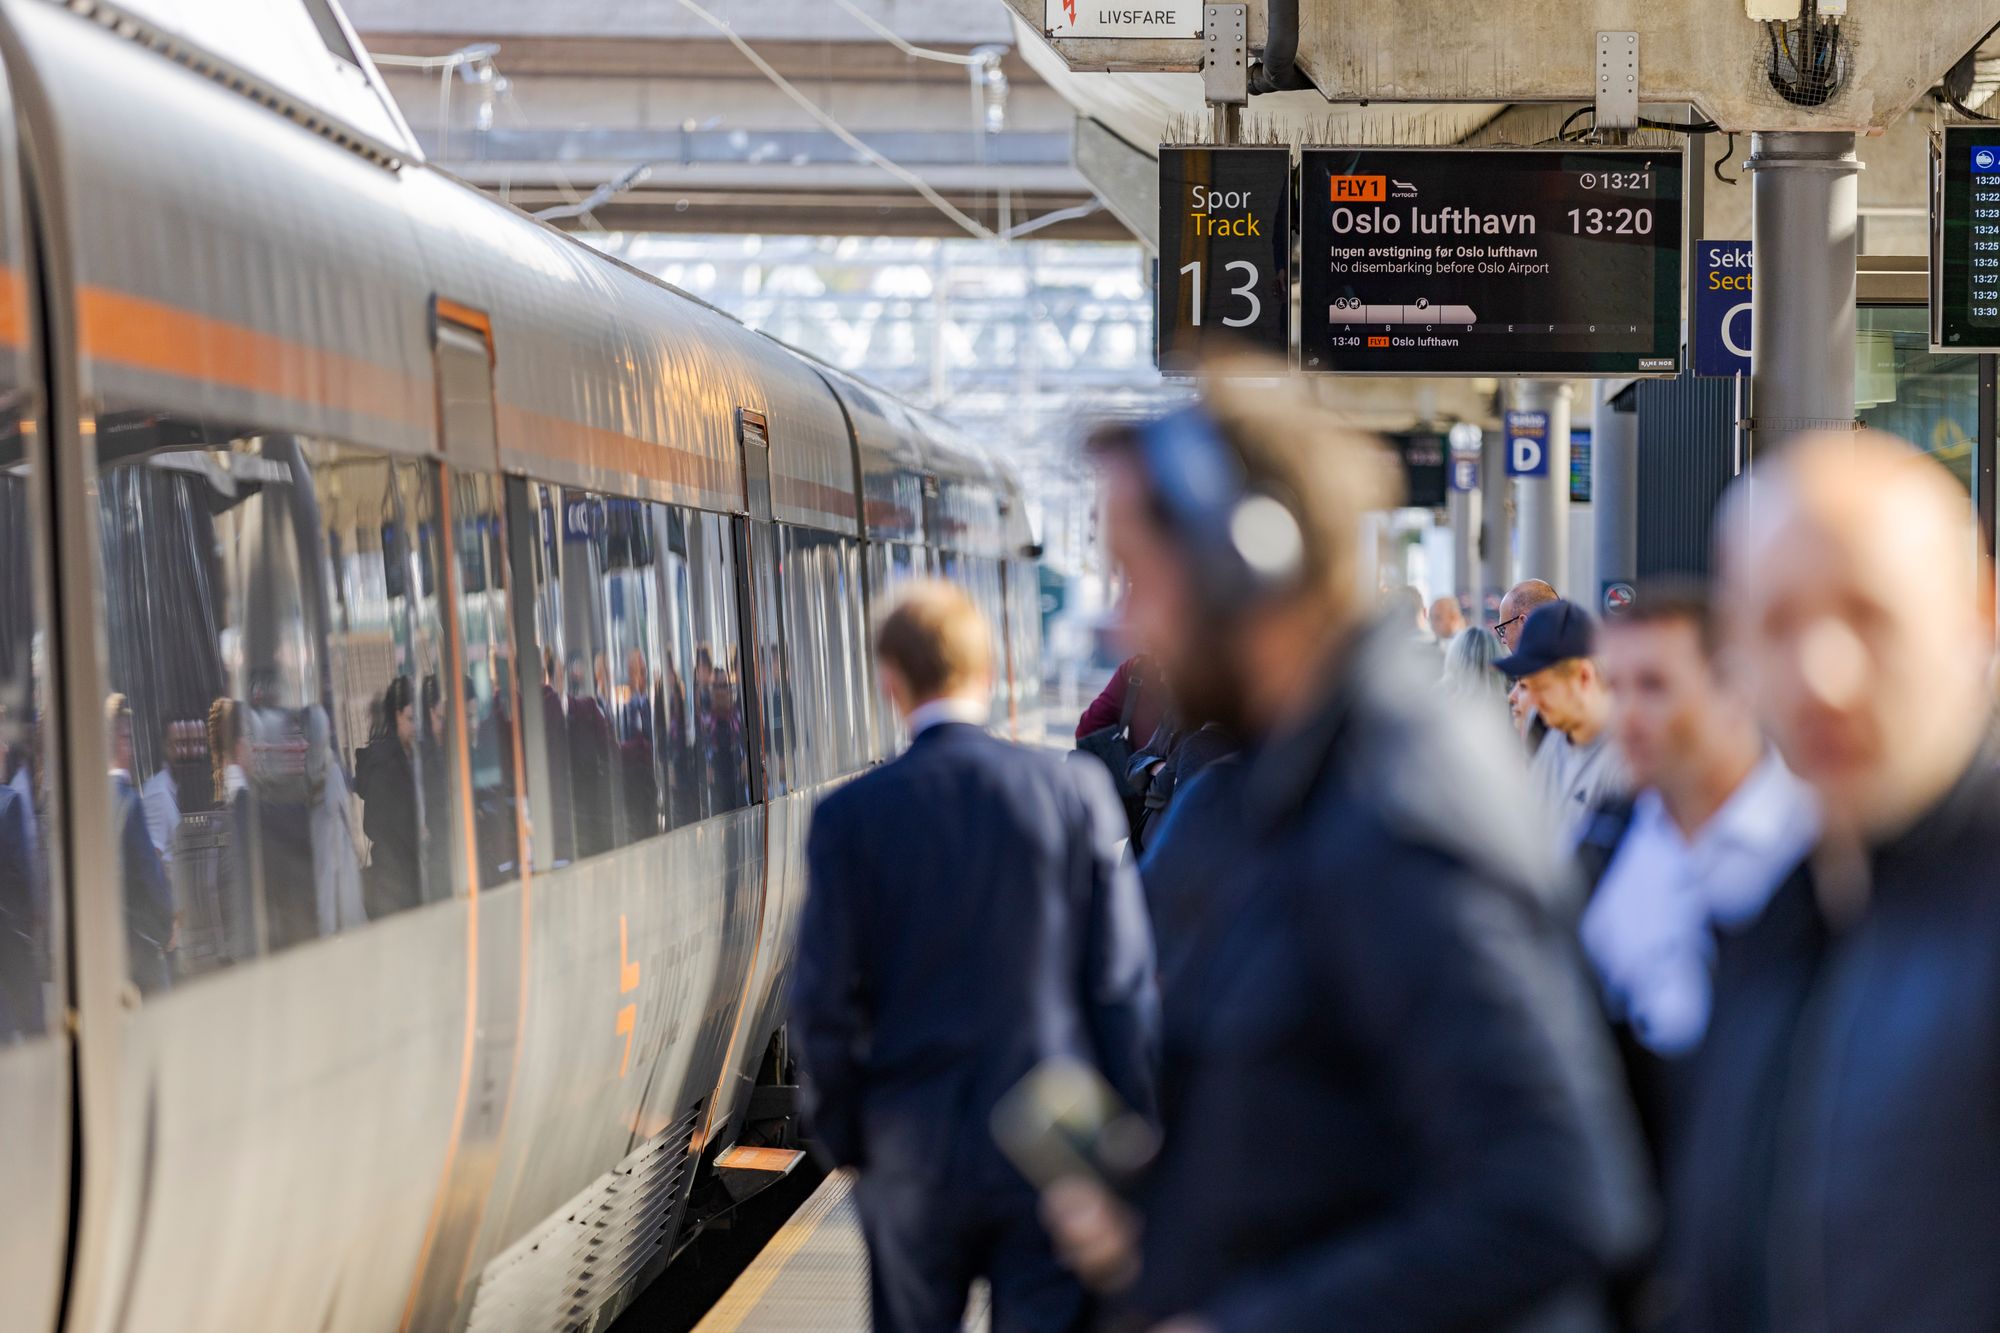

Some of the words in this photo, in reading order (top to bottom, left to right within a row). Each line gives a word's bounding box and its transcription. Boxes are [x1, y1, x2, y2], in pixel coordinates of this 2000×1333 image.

[1099, 10, 1176, 25] LIVSFARE
[1600, 172, 1650, 190] 13:21
[1975, 176, 2000, 185] 13:20
[1336, 180, 1367, 197] FLY
[1370, 180, 1379, 197] 1
[1191, 185, 1252, 214] Spor
[1975, 193, 2000, 202] 13:22
[1331, 207, 1401, 234] Oslo
[1411, 206, 1536, 234] lufthavn
[1567, 207, 1653, 235] 13:20
[1974, 209, 2000, 218] 13:23
[1190, 212, 1261, 237] Track
[1974, 225, 1999, 234] 13:24
[1330, 246, 1365, 260] Ingen
[1368, 245, 1432, 260] avstigning
[1435, 245, 1454, 258] før
[1456, 246, 1485, 258] Oslo
[1487, 246, 1538, 258] lufthavn
[1973, 242, 1999, 251] 13:25
[1709, 248, 1753, 268] Sekt
[1973, 258, 1999, 267] 13:26
[1330, 261, 1348, 273] No
[1351, 261, 1433, 276] disembarking
[1436, 261, 1475, 273] before
[1477, 261, 1505, 273] Oslo
[1507, 262, 1550, 276] Airport
[1709, 271, 1753, 290] Sect
[1973, 275, 1998, 283] 13:27
[1179, 260, 1261, 328] 13
[1973, 291, 1998, 300] 13:29
[1972, 307, 1998, 316] 13:30
[1344, 324, 1351, 332] A
[1385, 324, 1391, 332] B
[1426, 324, 1432, 332] C
[1467, 324, 1473, 332] D
[1332, 337, 1361, 346] 13:40
[1370, 337, 1382, 346] FLY
[1391, 337, 1415, 346] Oslo
[1417, 337, 1459, 346] lufthavn
[1512, 437, 1542, 472] D
